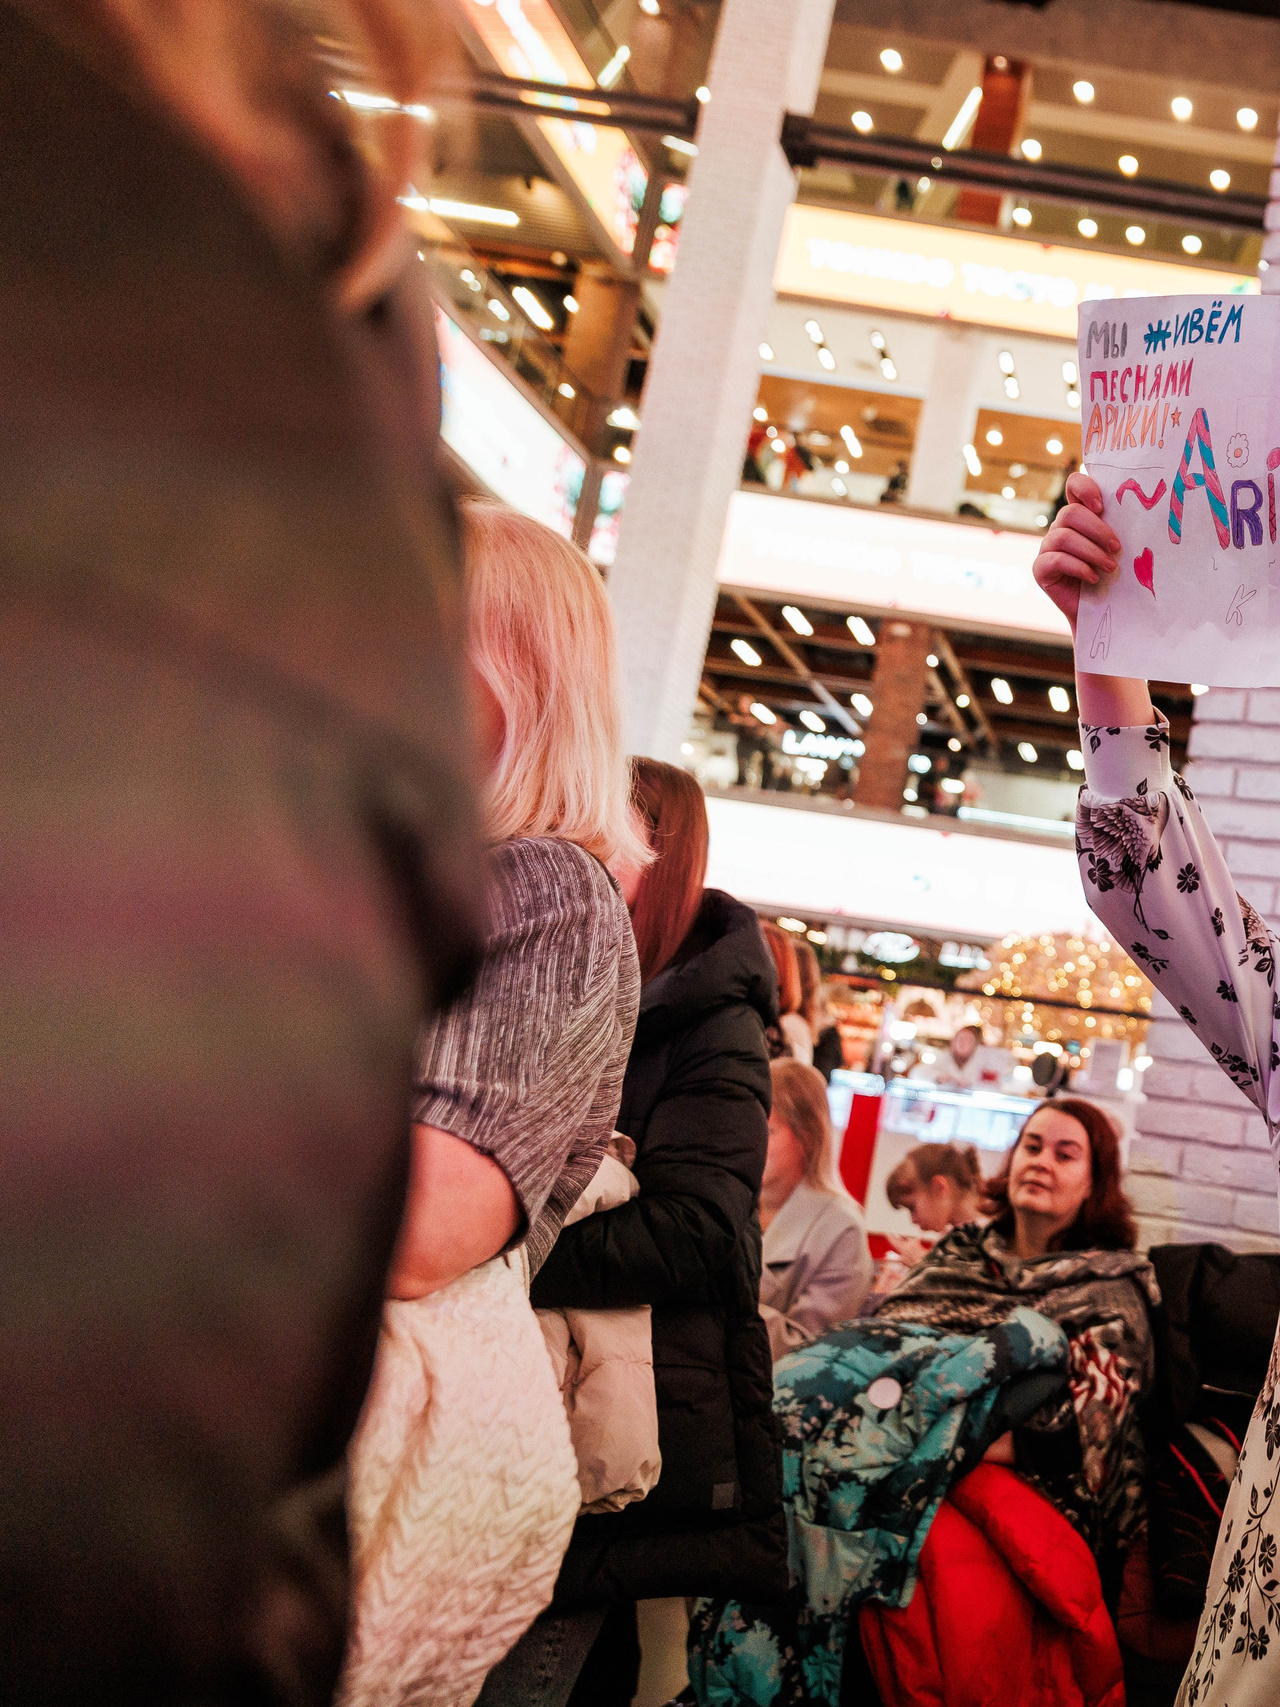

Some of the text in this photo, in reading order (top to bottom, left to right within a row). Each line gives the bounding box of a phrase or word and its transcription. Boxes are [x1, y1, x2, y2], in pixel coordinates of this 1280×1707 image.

[1086, 300, 1244, 359] МЫ ЖИВЁМ
[1090, 358, 1194, 403] ПЕСНЯМИ
